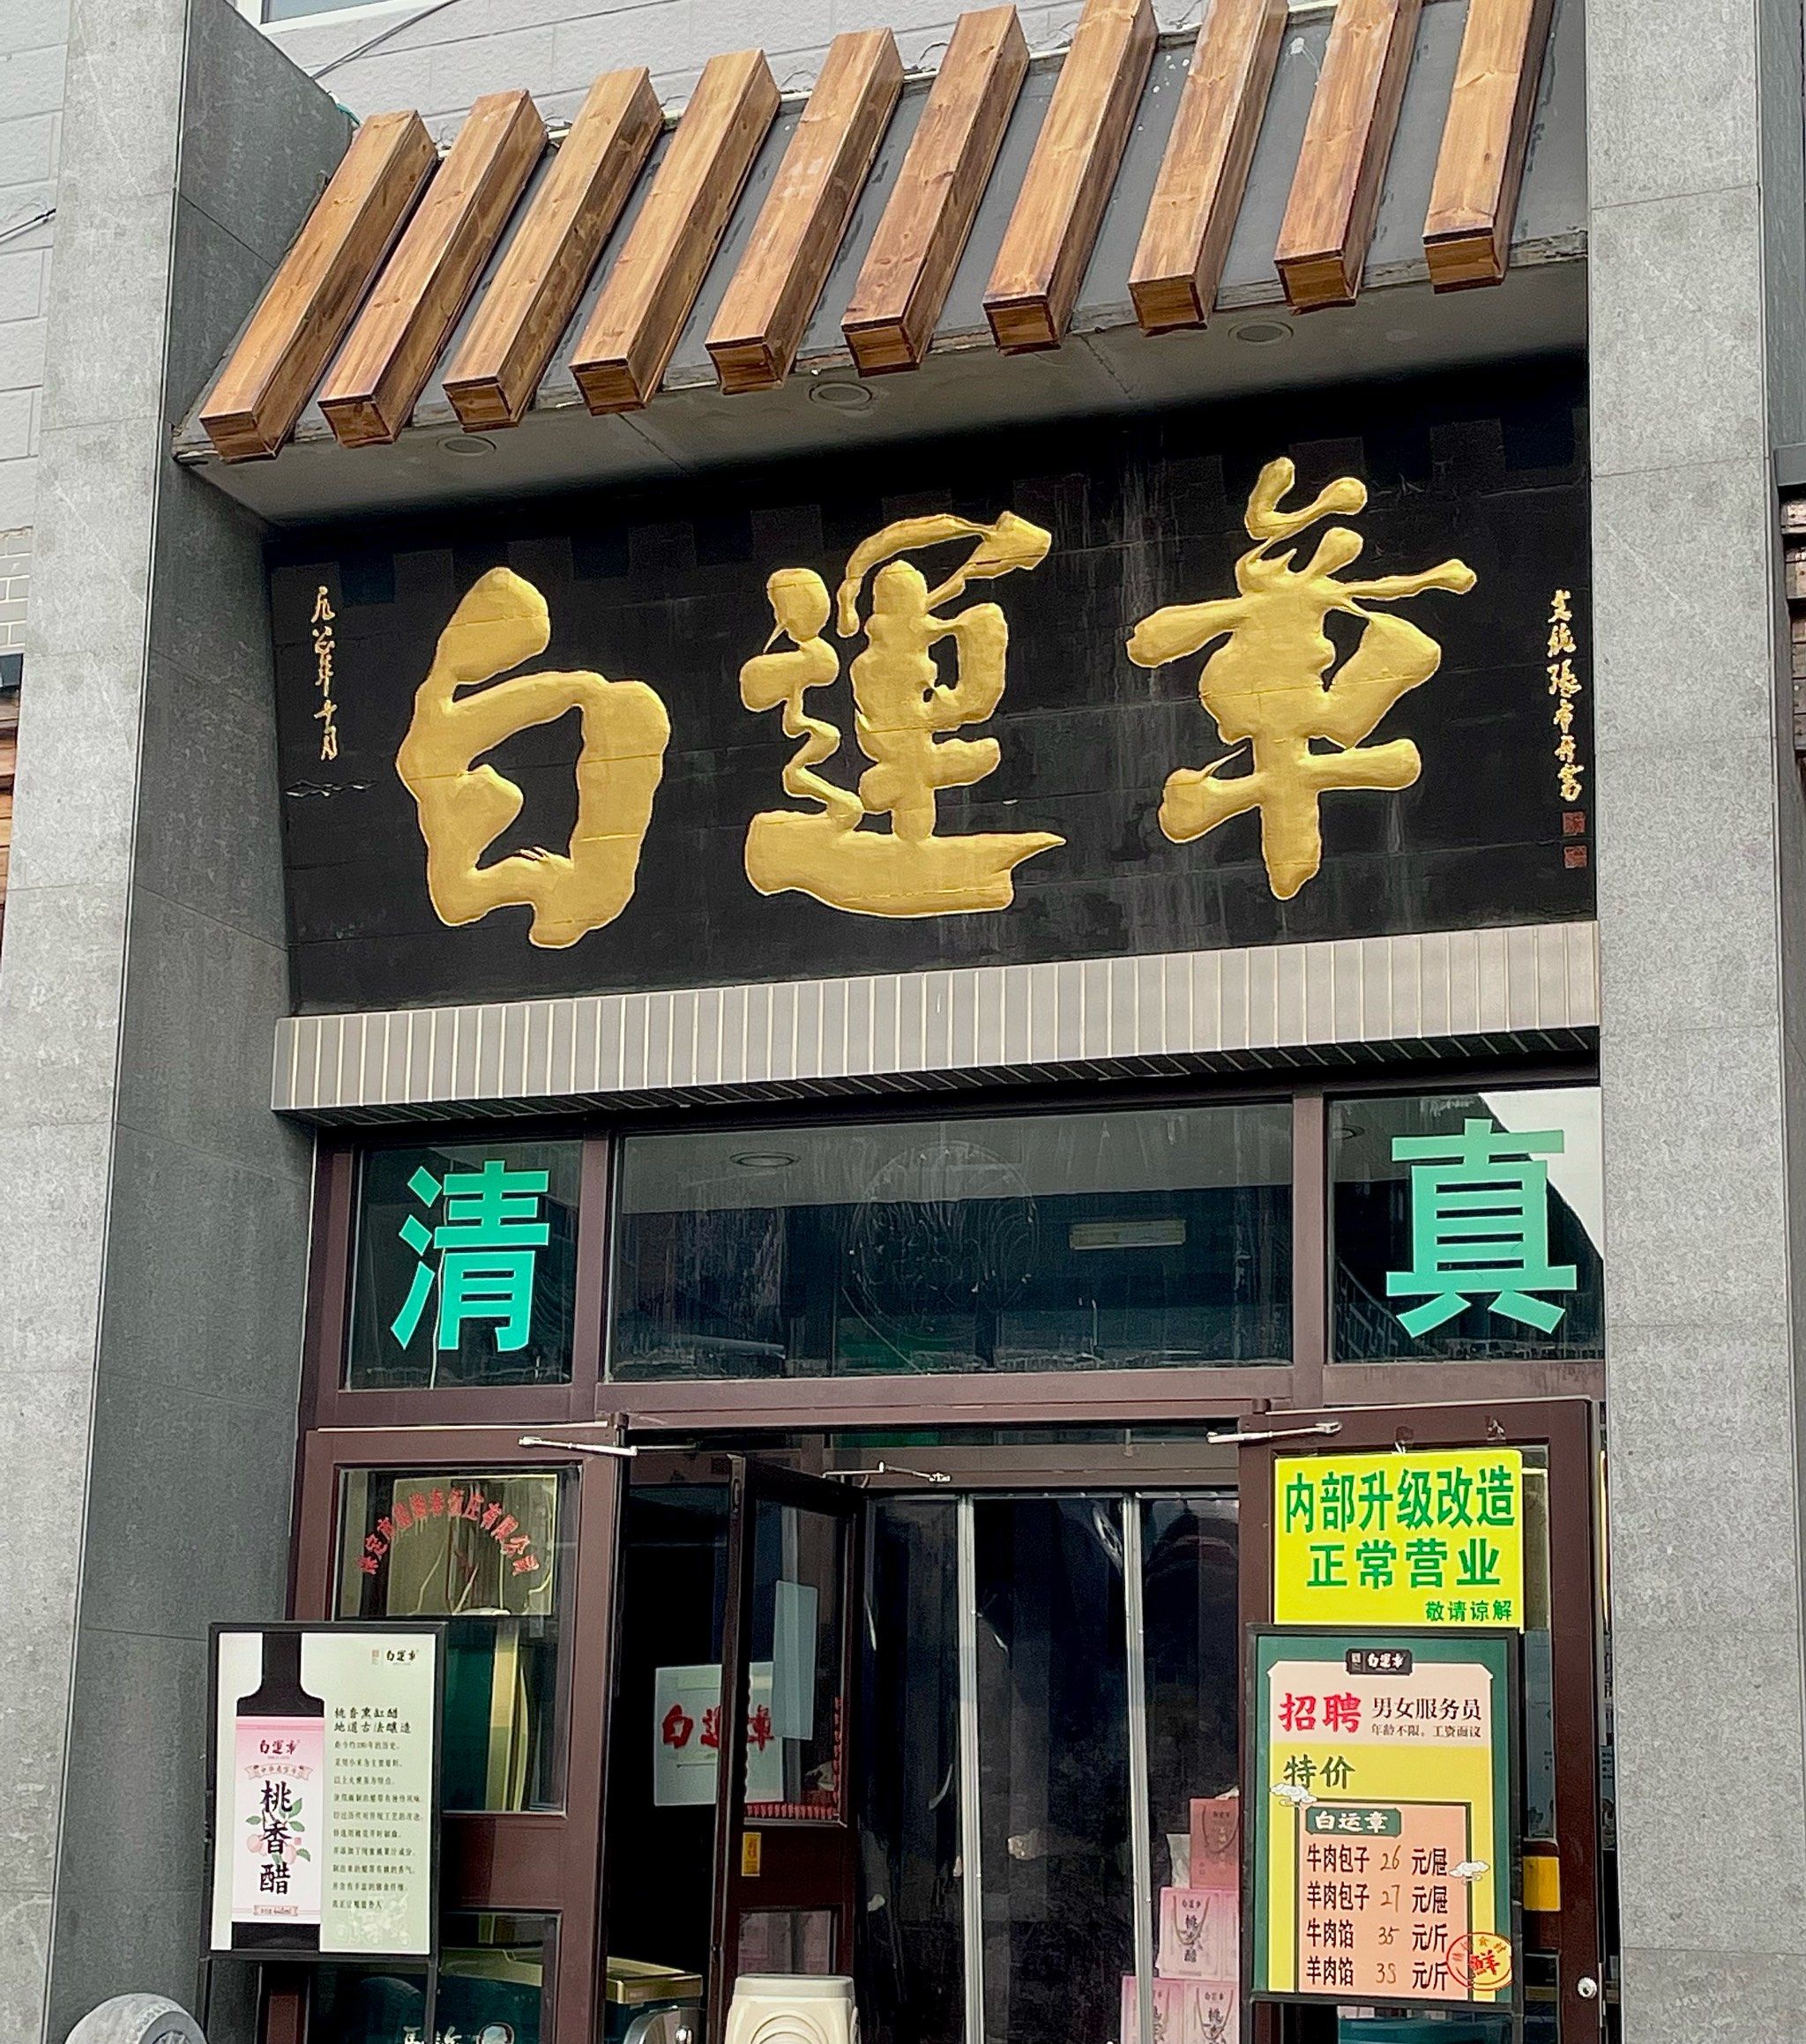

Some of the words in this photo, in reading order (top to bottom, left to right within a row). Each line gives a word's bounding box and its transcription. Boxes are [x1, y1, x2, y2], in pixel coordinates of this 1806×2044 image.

[391, 1160, 551, 1353] 清
[1385, 1117, 1578, 1339] 真
[1286, 1465, 1515, 1533] 内部升级改造
[1306, 1537, 1501, 1590] 正常营业
[1424, 1599, 1512, 1623] 敬请谅解
[1277, 1691, 1362, 1734] 招聘
[1371, 1697, 1482, 1721] 男女服务员
[1283, 1753, 1356, 1790] 特价
[258, 1779, 294, 1895] 桃香醋
[1315, 1810, 1389, 1833] 白运章
[1306, 1842, 1370, 1874] 牛肉包子
[1379, 1844, 1402, 1872] 26
[1306, 1879, 1370, 1912] 羊肉包子
[1379, 1884, 1401, 1913] 27
[1306, 1917, 1354, 1950] 牛肉馅
[1377, 1925, 1400, 1946] 35
[1411, 1922, 1449, 1953] 元/斤
[1306, 1955, 1354, 1987] 羊肉馅
[1411, 1961, 1449, 1992] 元/斤
[1469, 1949, 1502, 1976] 鲜
